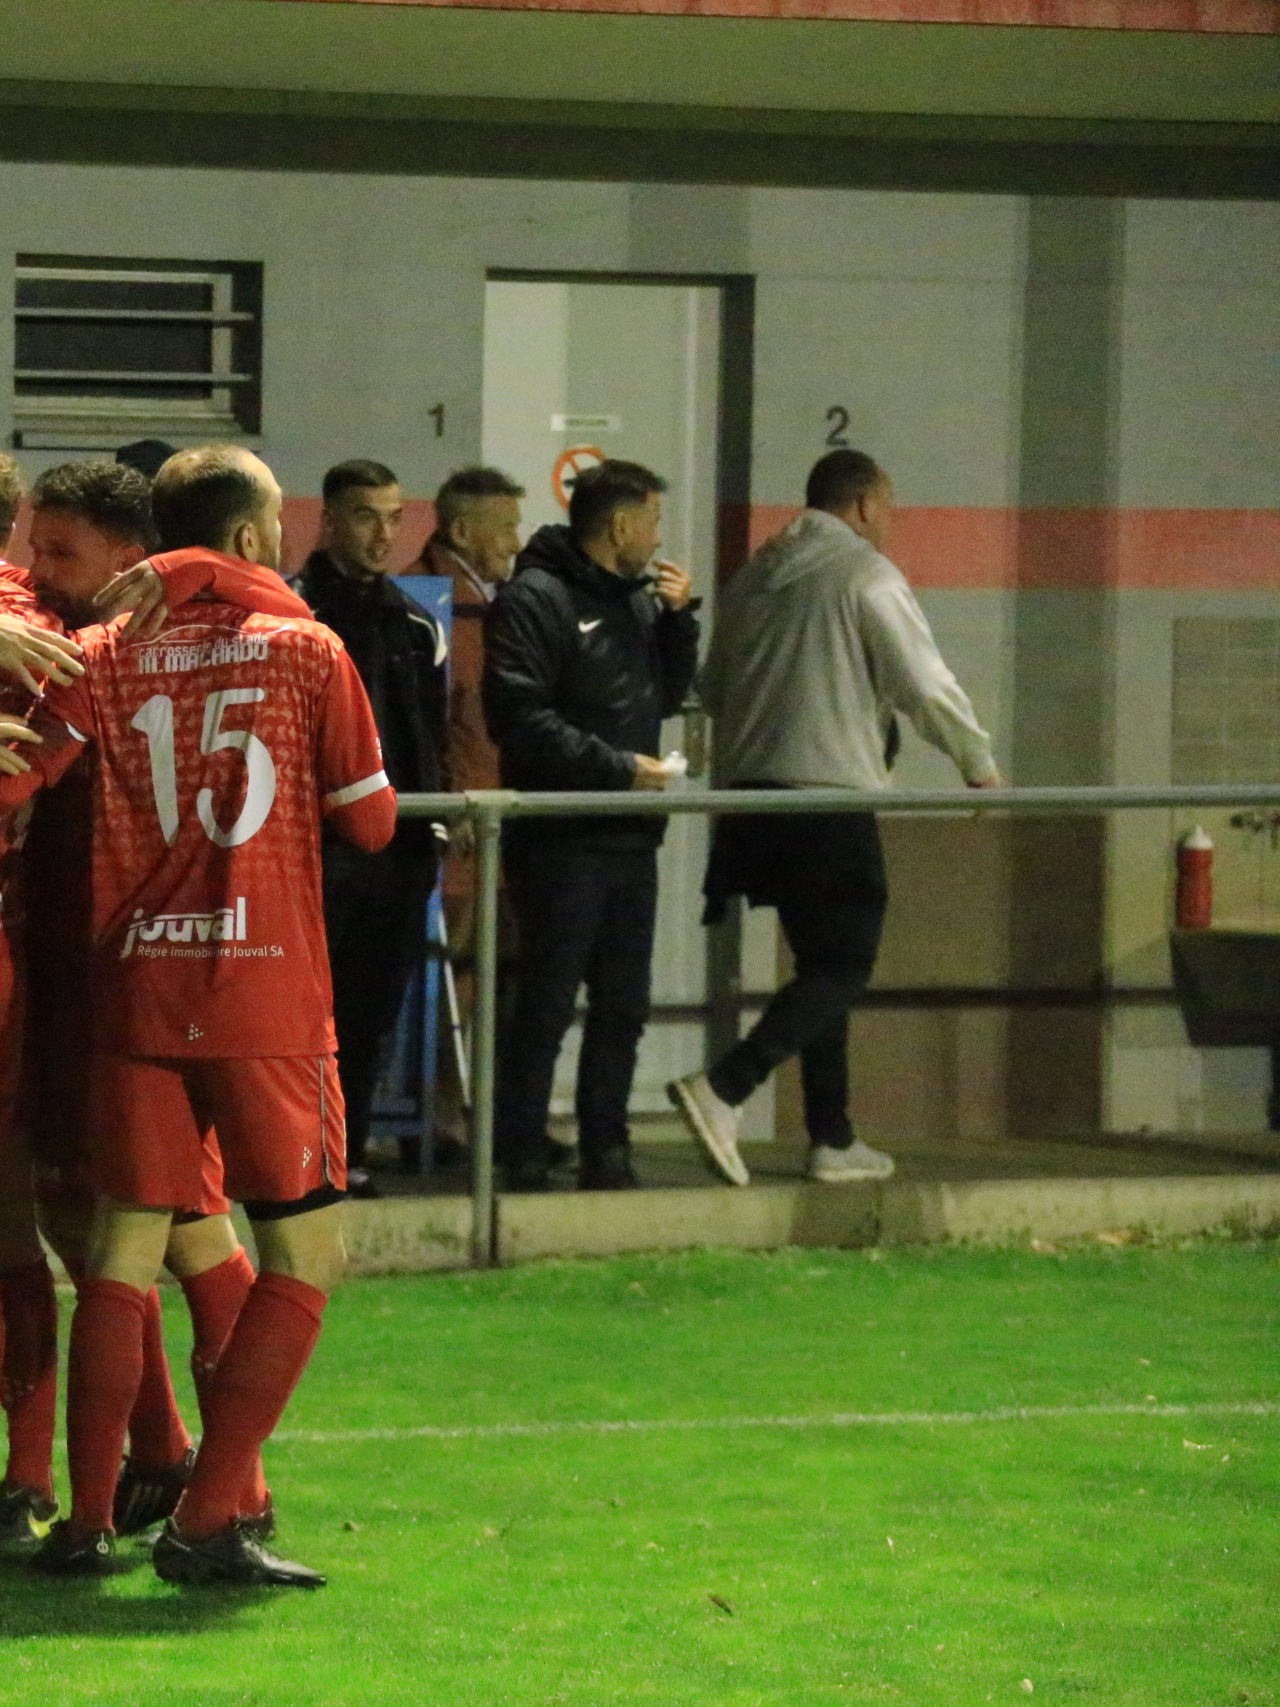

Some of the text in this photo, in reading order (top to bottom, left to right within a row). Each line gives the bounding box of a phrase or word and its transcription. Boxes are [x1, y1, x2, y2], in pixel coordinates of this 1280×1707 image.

[427, 402, 445, 437] 1
[825, 405, 849, 447] 2
[131, 688, 277, 848] 15
[120, 897, 247, 959] jouval
[138, 945, 168, 958] Régie
[233, 946, 267, 958] Jouval
[271, 946, 285, 957] SA
